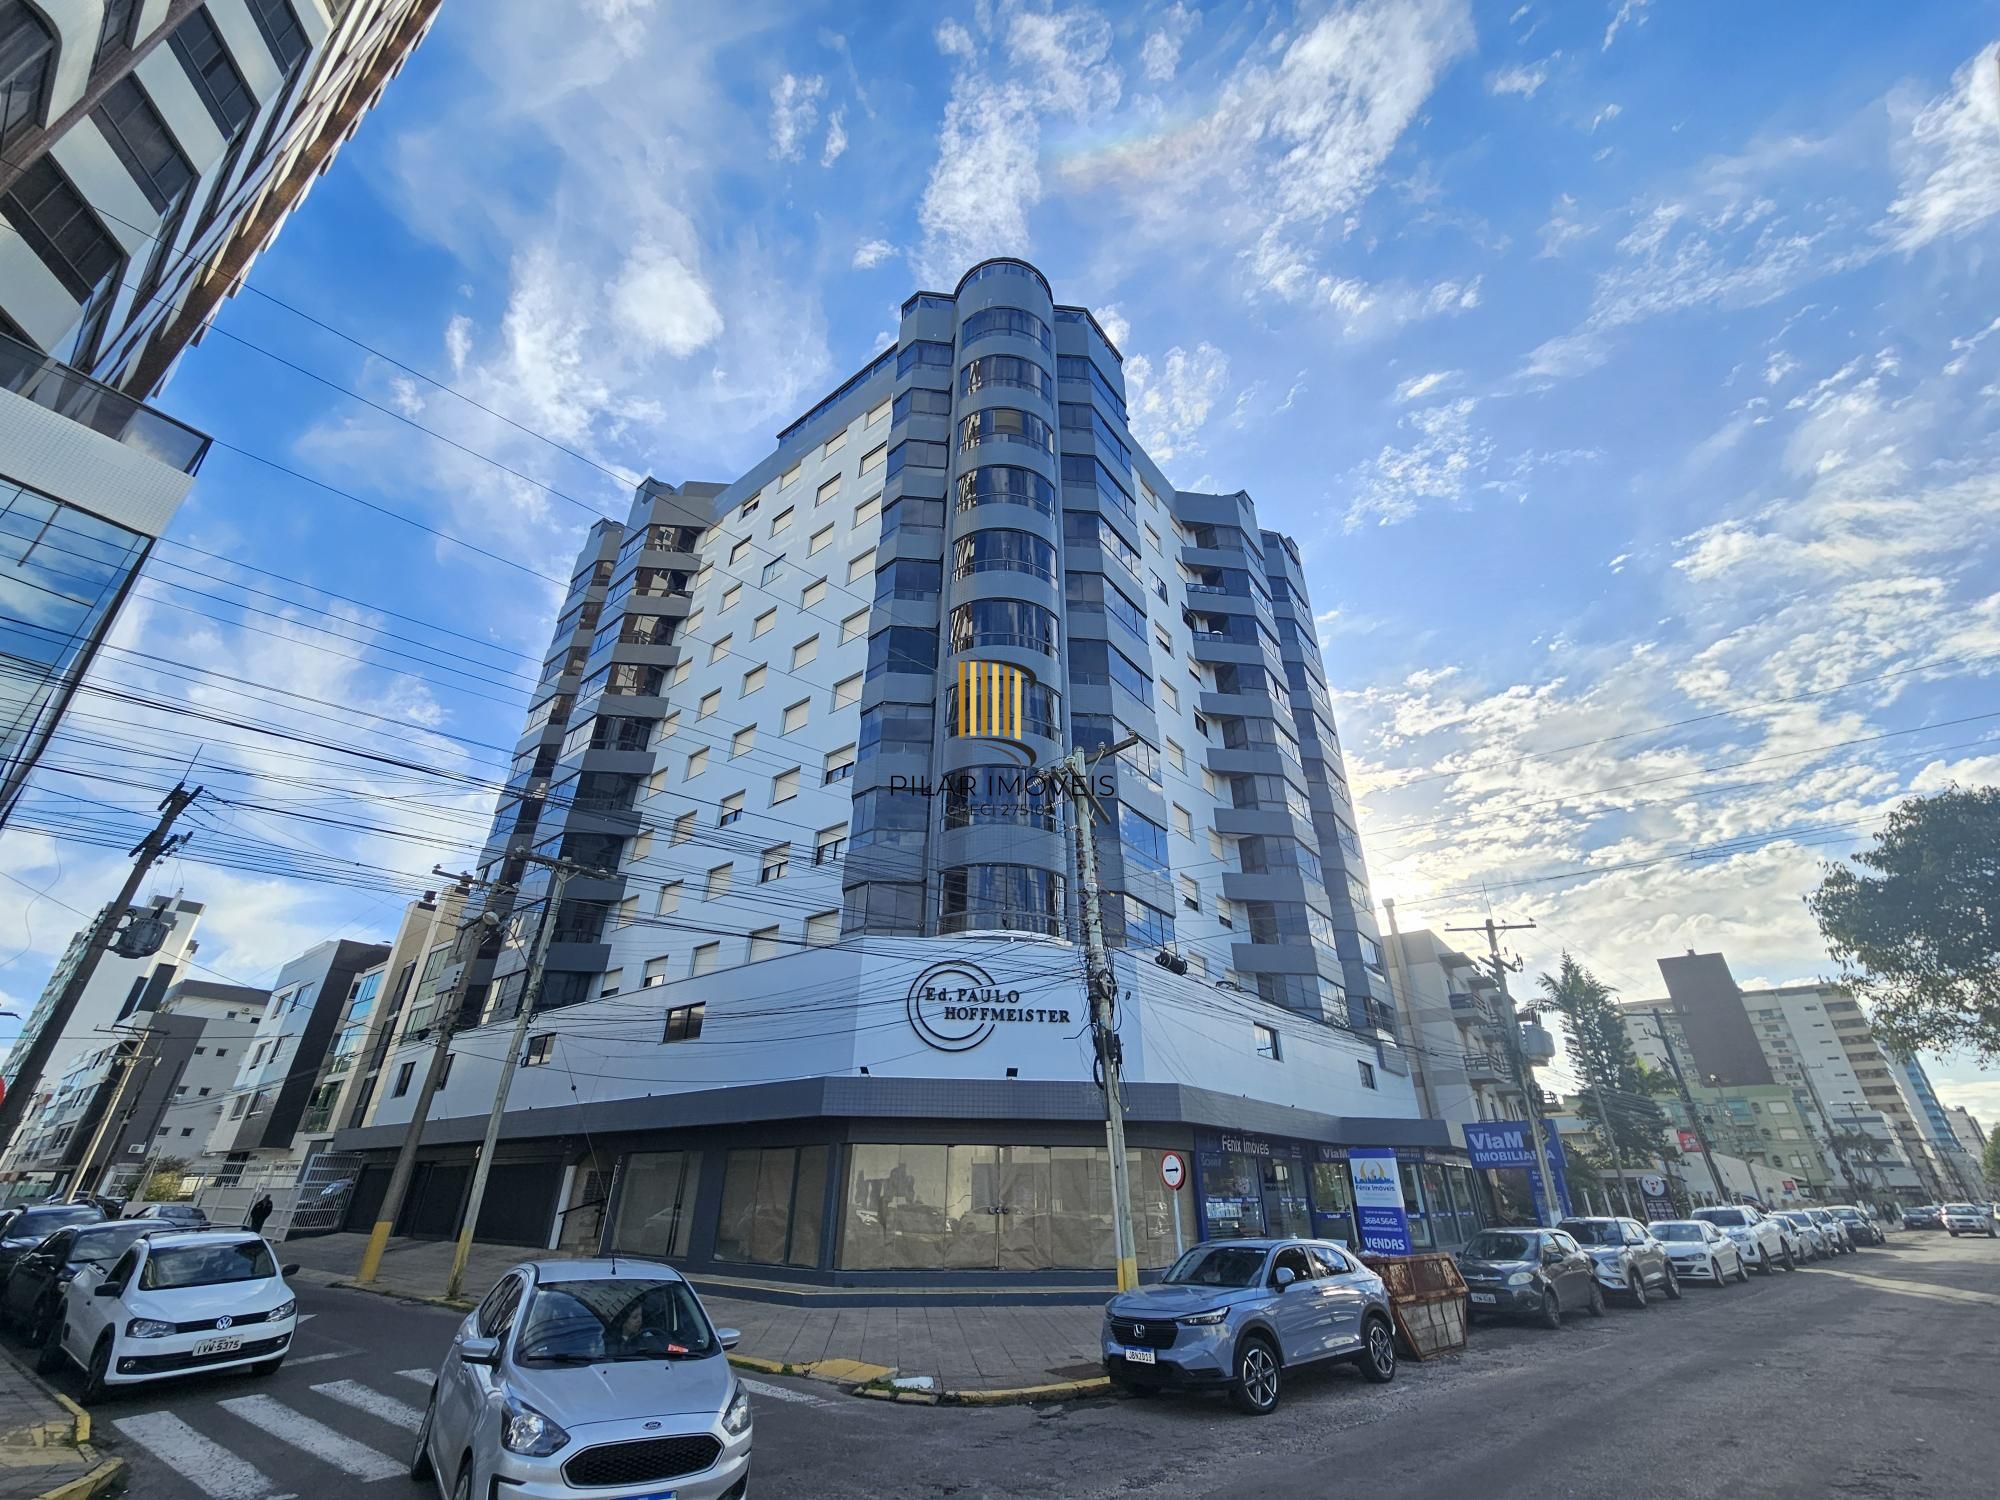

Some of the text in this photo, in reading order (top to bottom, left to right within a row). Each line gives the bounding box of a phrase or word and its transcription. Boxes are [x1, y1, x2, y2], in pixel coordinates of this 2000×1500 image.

[925, 987, 1020, 1004] Ed. PAULO
[944, 1006, 1071, 1023] HOFFMEISTER
[1468, 1131, 1524, 1150] ViaM
[1364, 1236, 1406, 1251] VENDAS
